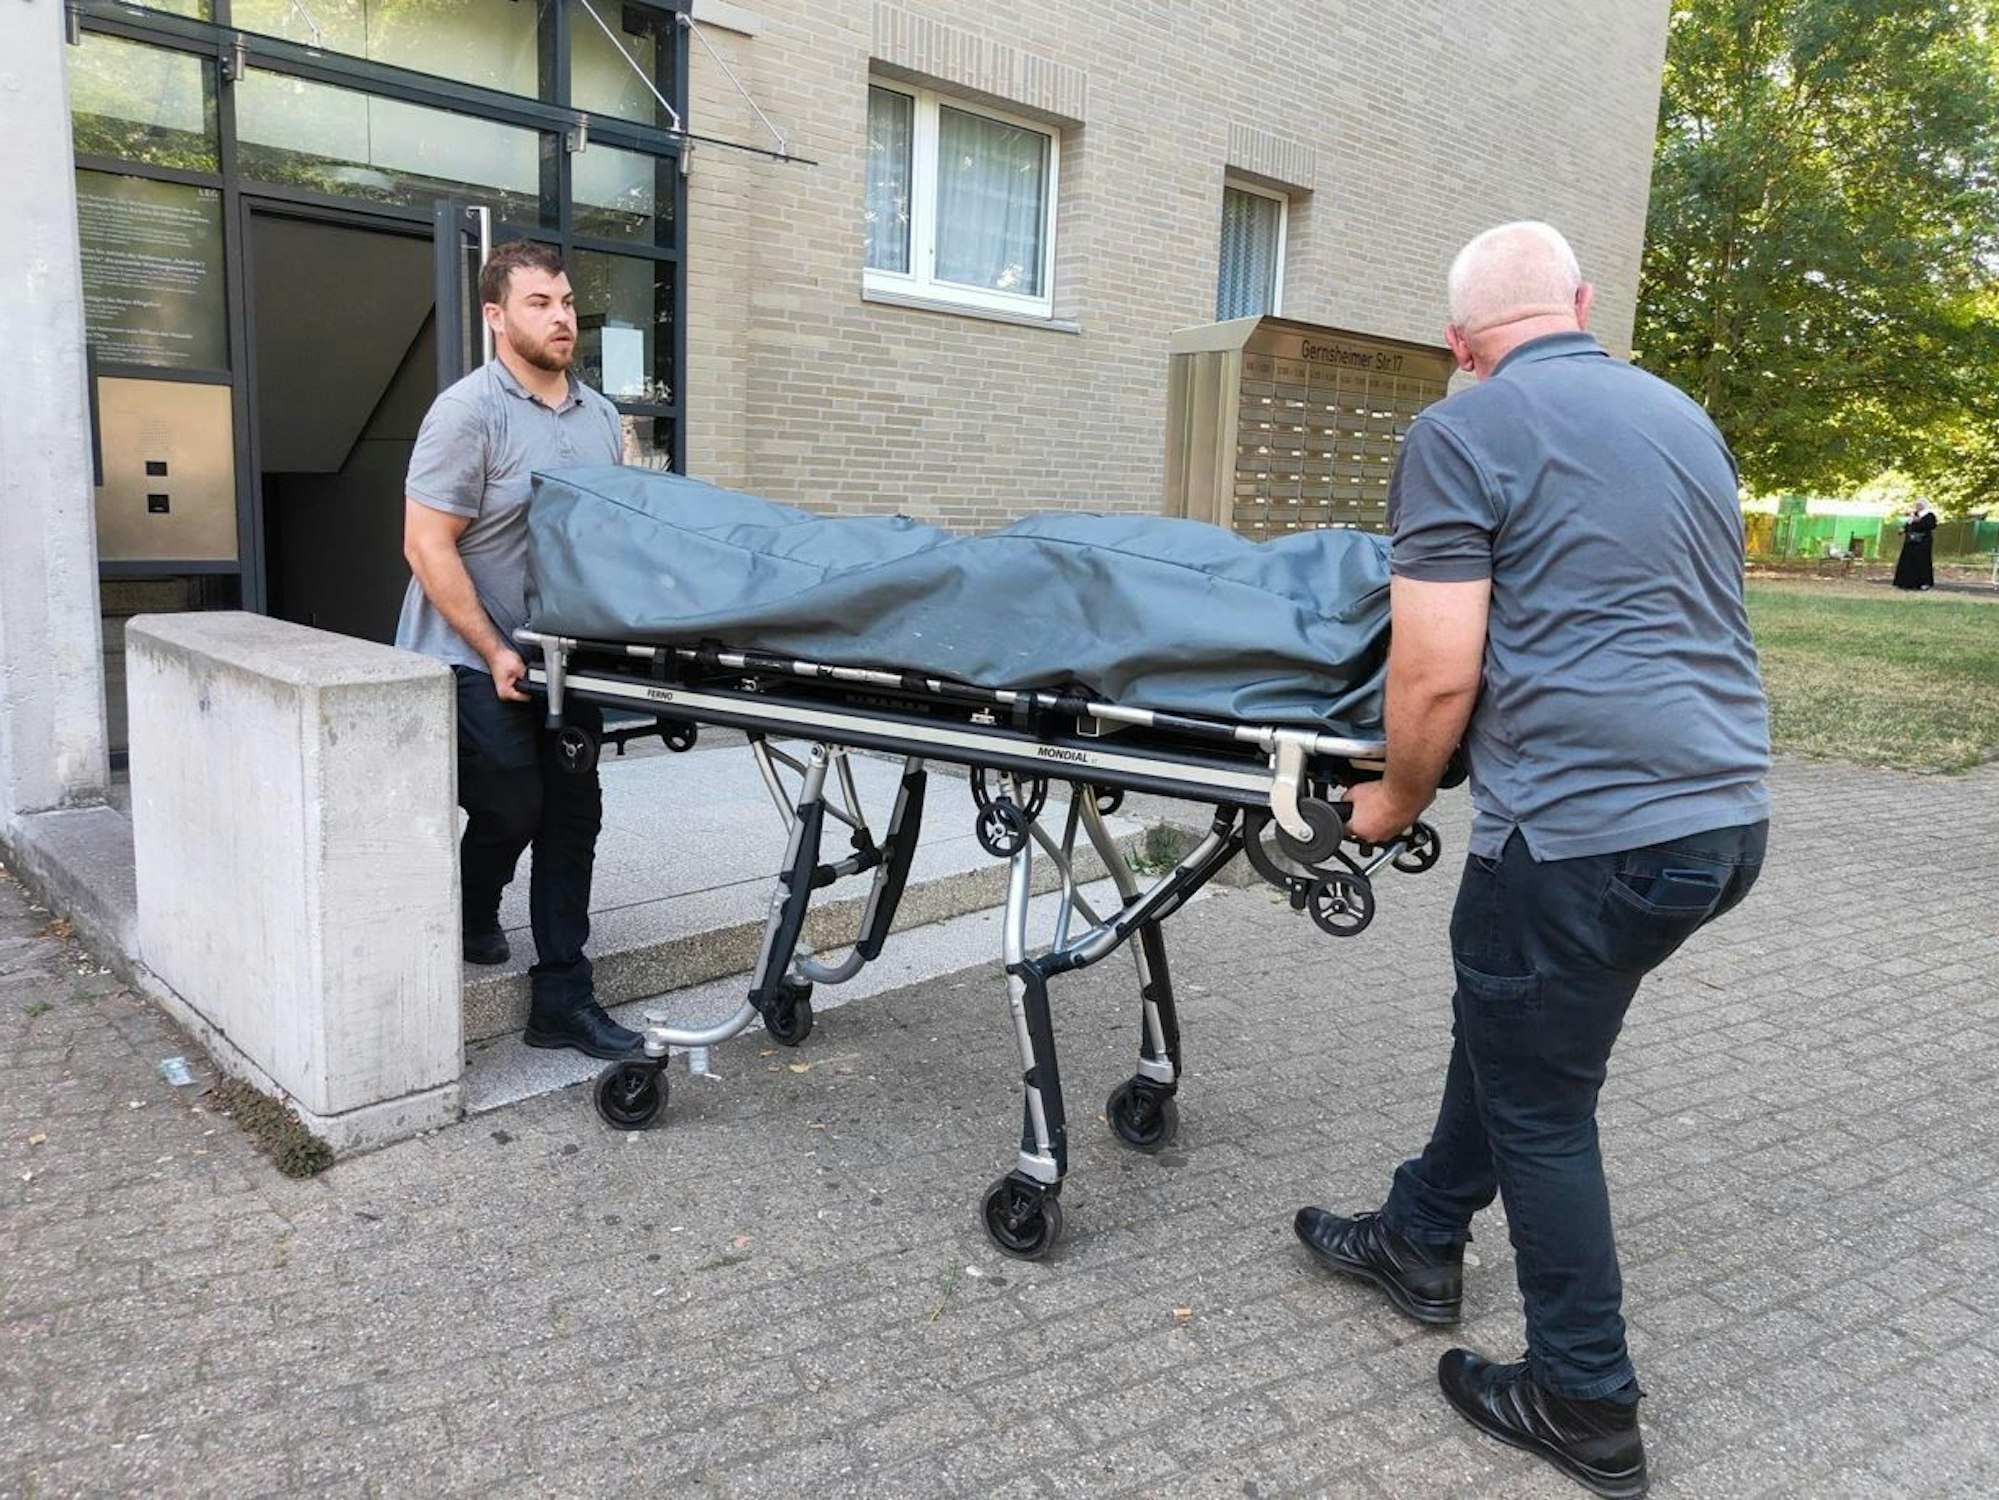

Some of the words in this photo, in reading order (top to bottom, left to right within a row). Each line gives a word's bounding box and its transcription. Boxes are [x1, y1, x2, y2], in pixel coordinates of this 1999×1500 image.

[1302, 339, 1373, 368] Gernsheimer
[647, 688, 673, 701] FERNO
[1038, 747, 1089, 763] MONDIAL
